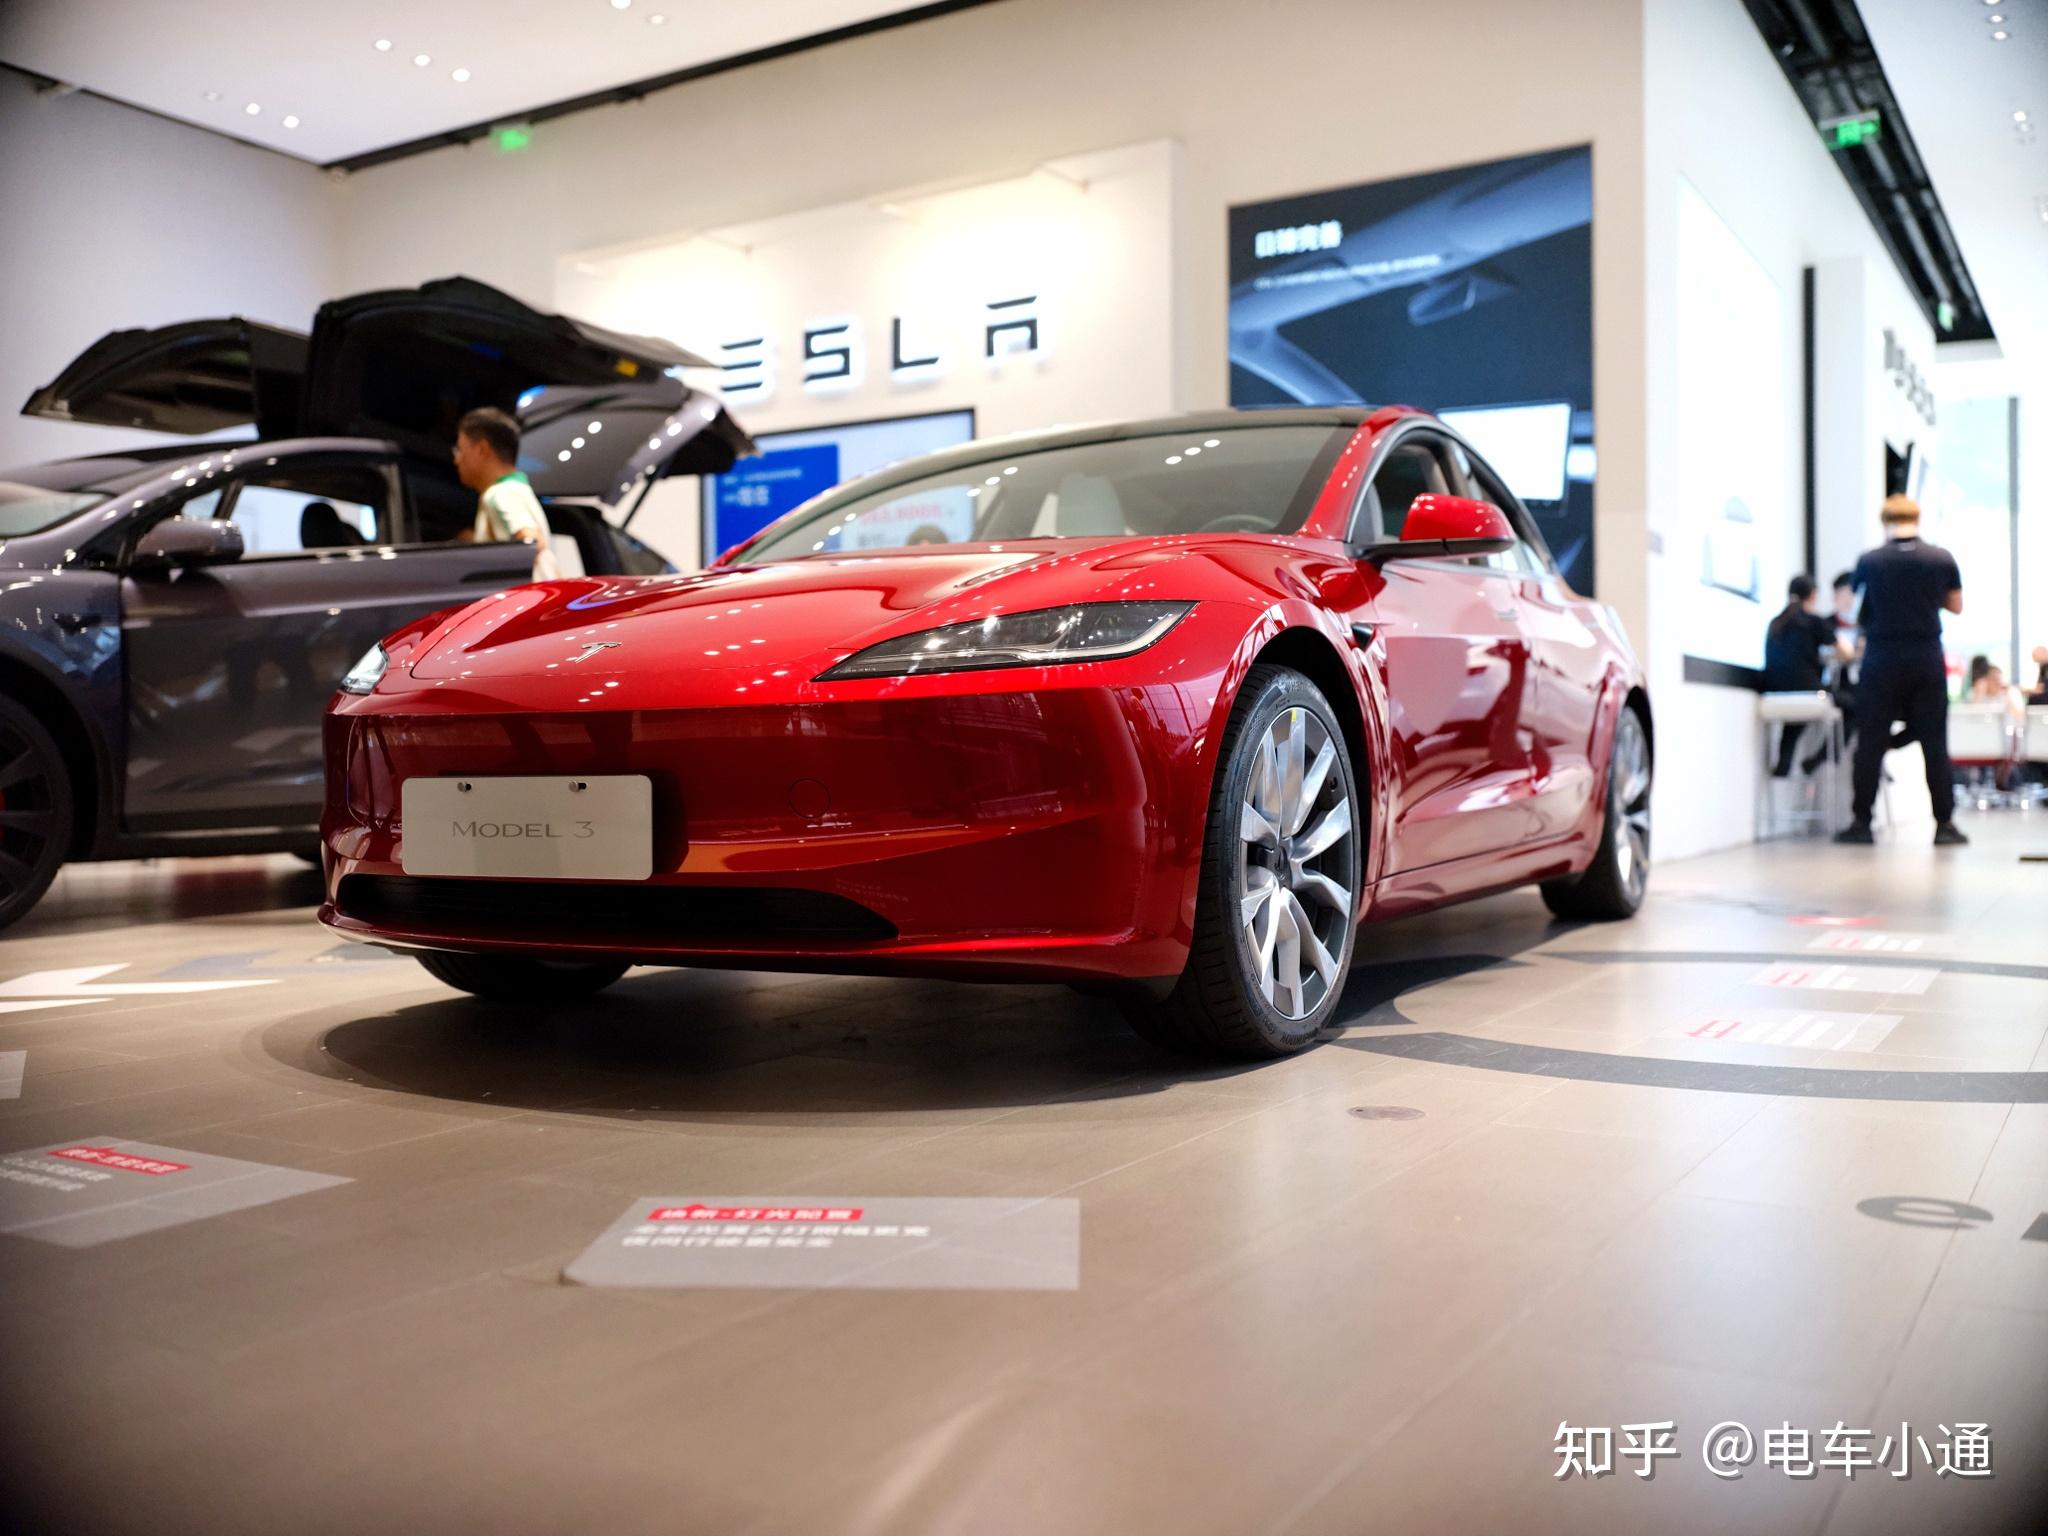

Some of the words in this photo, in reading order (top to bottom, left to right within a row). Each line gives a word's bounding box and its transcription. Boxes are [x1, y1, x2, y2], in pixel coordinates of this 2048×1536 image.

[719, 296, 1038, 393] ESLA
[452, 821, 563, 838] MODEL
[573, 820, 595, 839] 3
